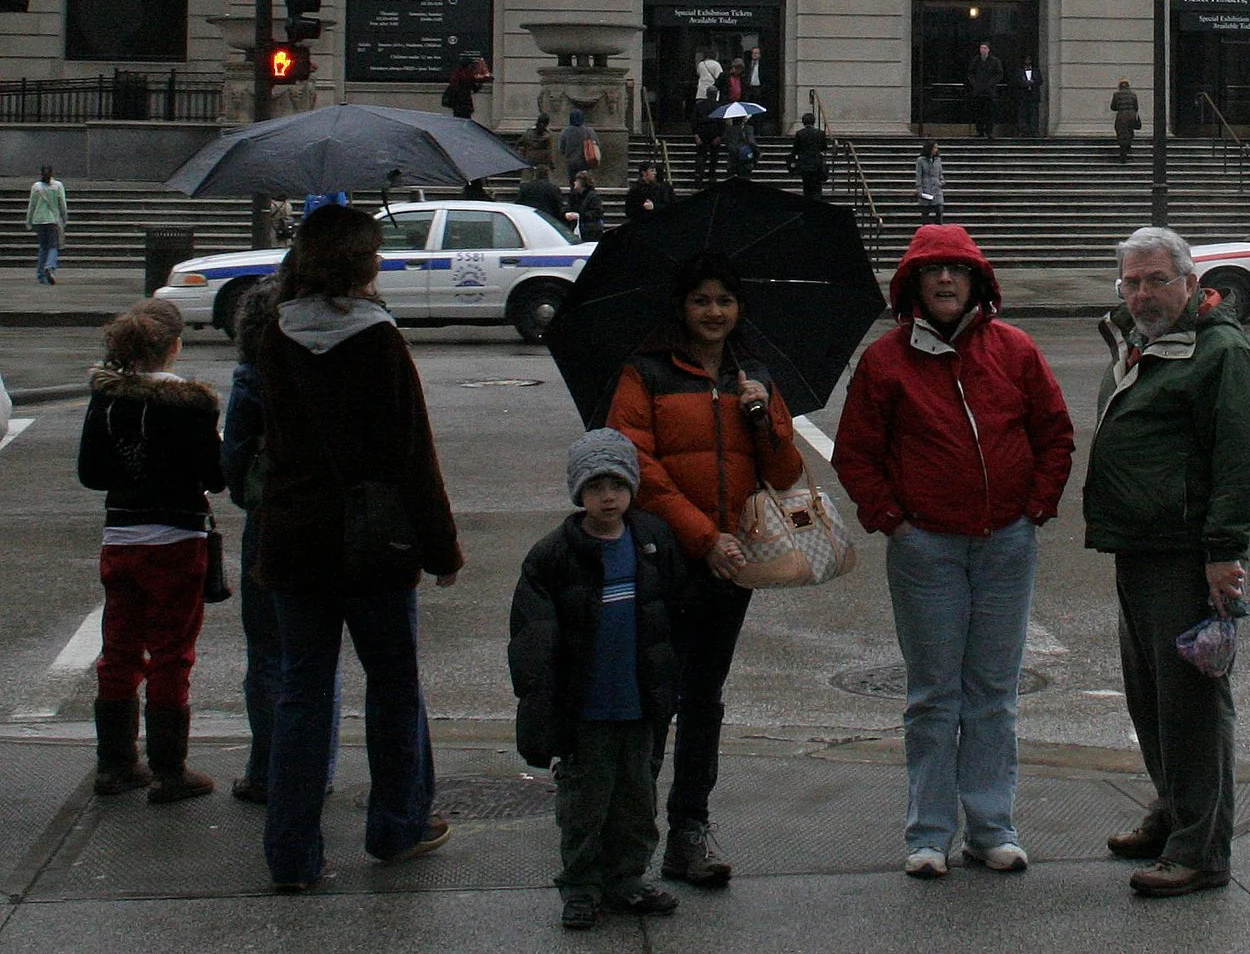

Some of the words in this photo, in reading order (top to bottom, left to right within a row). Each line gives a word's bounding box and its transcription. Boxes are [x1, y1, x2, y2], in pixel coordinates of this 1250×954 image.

[674, 9, 697, 18] Special
[730, 9, 753, 17] Tickets
[718, 16, 738, 25] Today
[1199, 15, 1219, 23] Special
[456, 252, 485, 262] 5581
